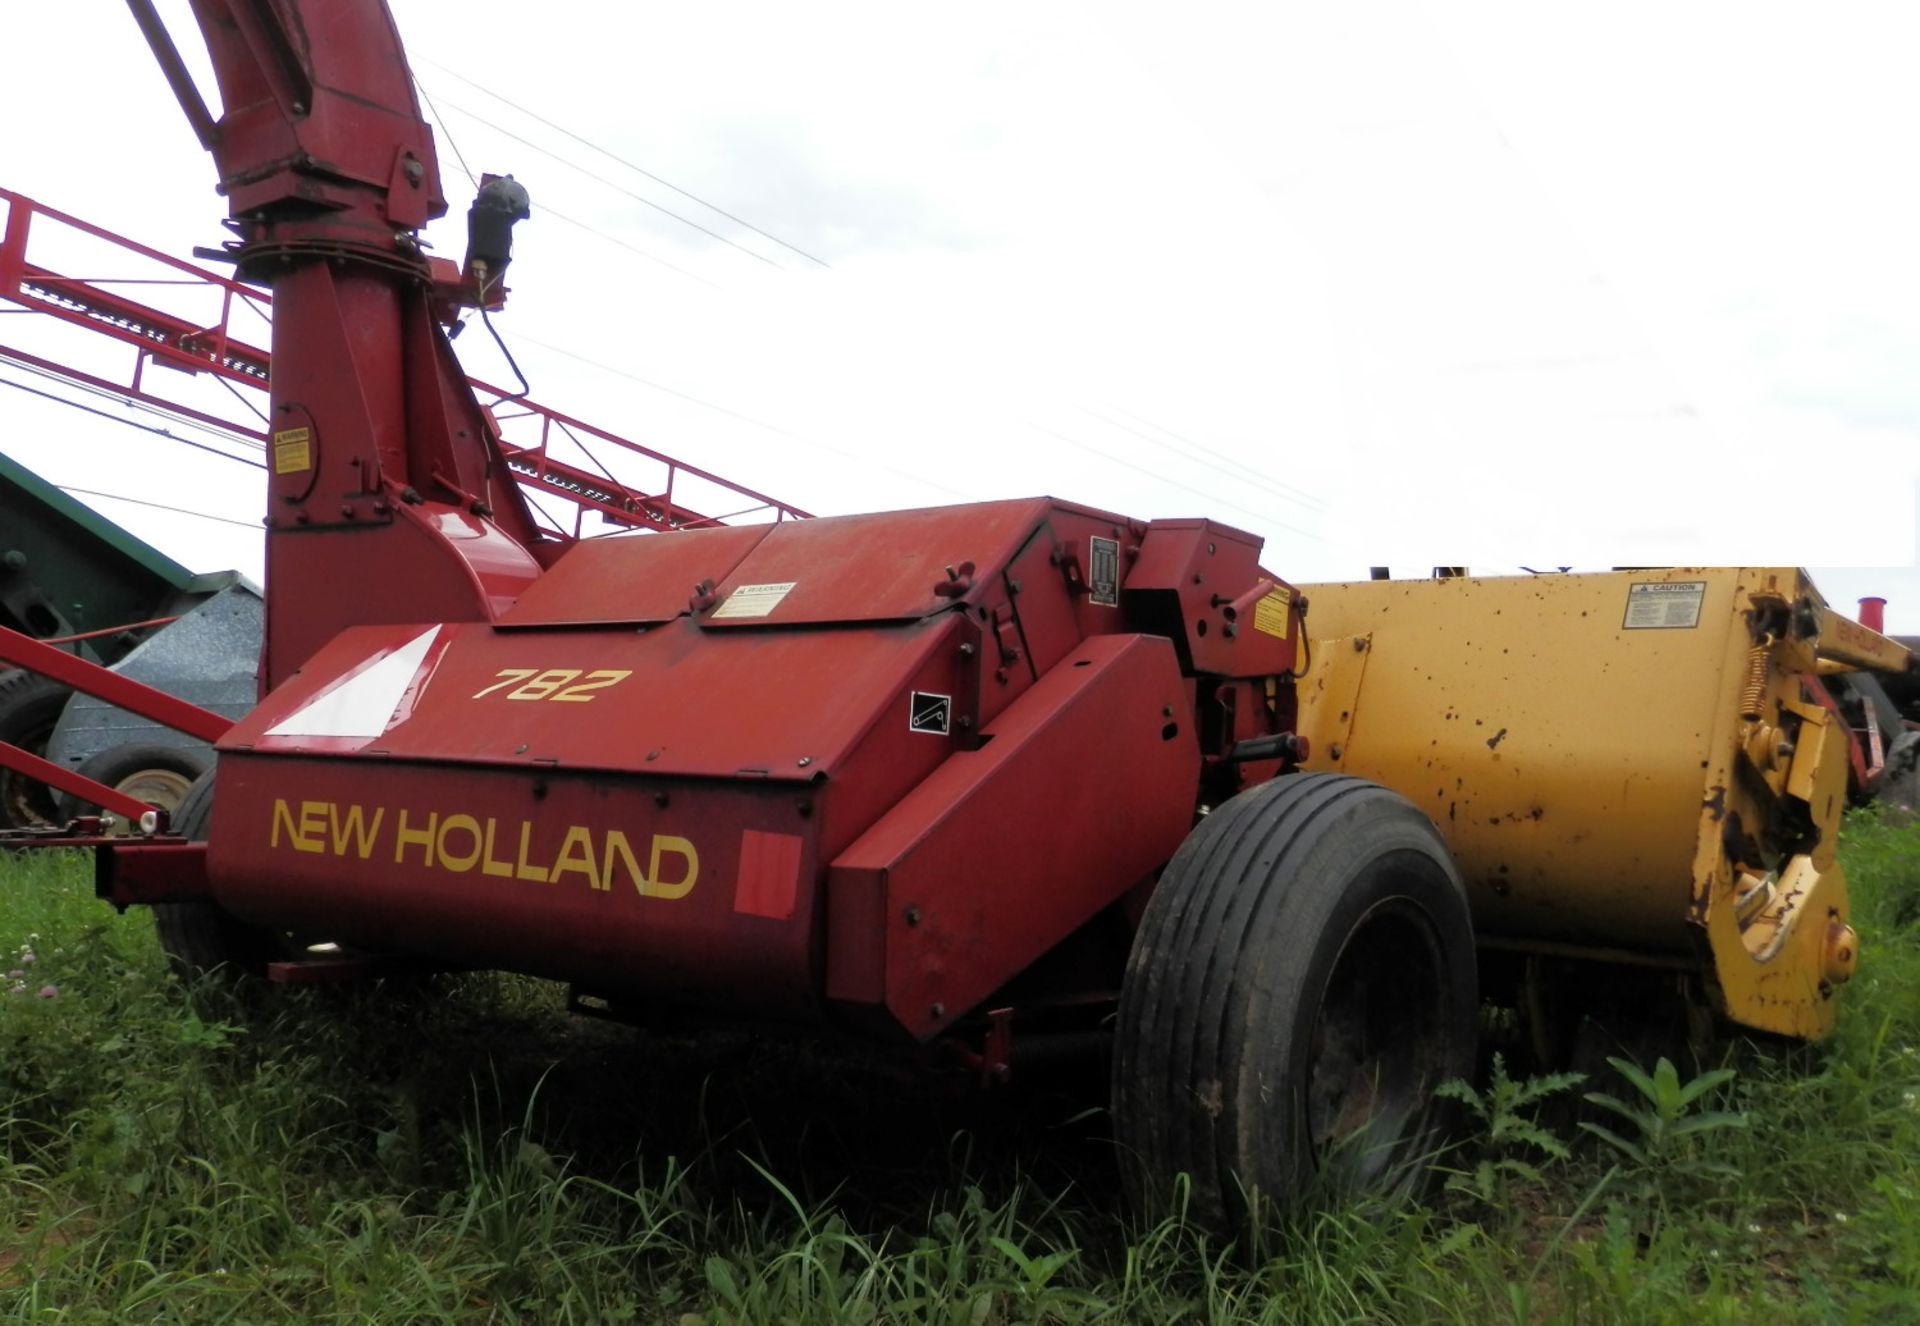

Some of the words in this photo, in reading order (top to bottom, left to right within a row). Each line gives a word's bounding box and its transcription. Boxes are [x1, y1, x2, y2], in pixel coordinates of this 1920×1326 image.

[472, 669, 633, 702] 782
[270, 798, 385, 860] NEW
[394, 809, 699, 900] HOLLAND
